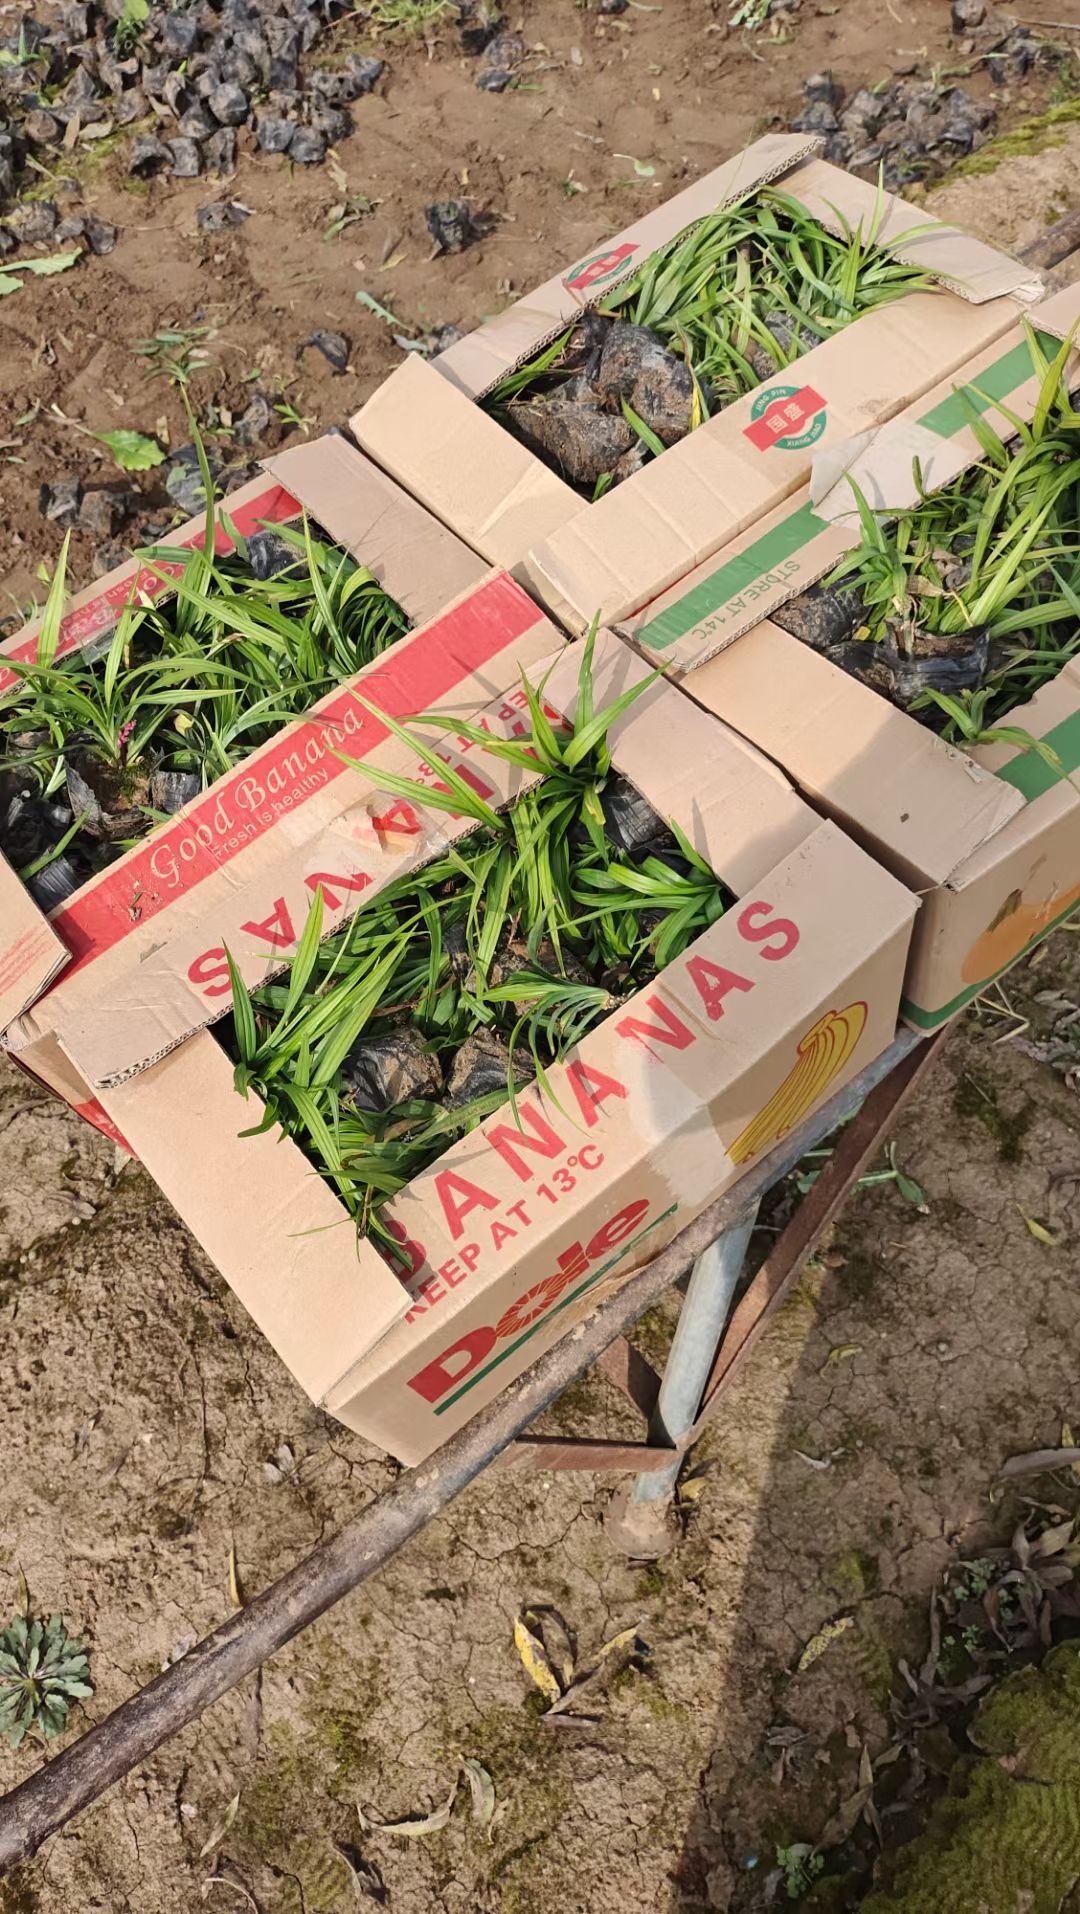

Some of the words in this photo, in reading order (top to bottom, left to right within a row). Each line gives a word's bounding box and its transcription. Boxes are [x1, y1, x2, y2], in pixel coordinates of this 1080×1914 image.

[725, 596, 747, 618] AT
[743, 560, 801, 601] STORE
[150, 791, 236, 888] Good
[234, 707, 364, 813] Banana
[209, 822, 258, 857] Fresh
[270, 767, 329, 815] healthy
[489, 1199, 533, 1251] AT
[406, 1198, 650, 1403] Dole
